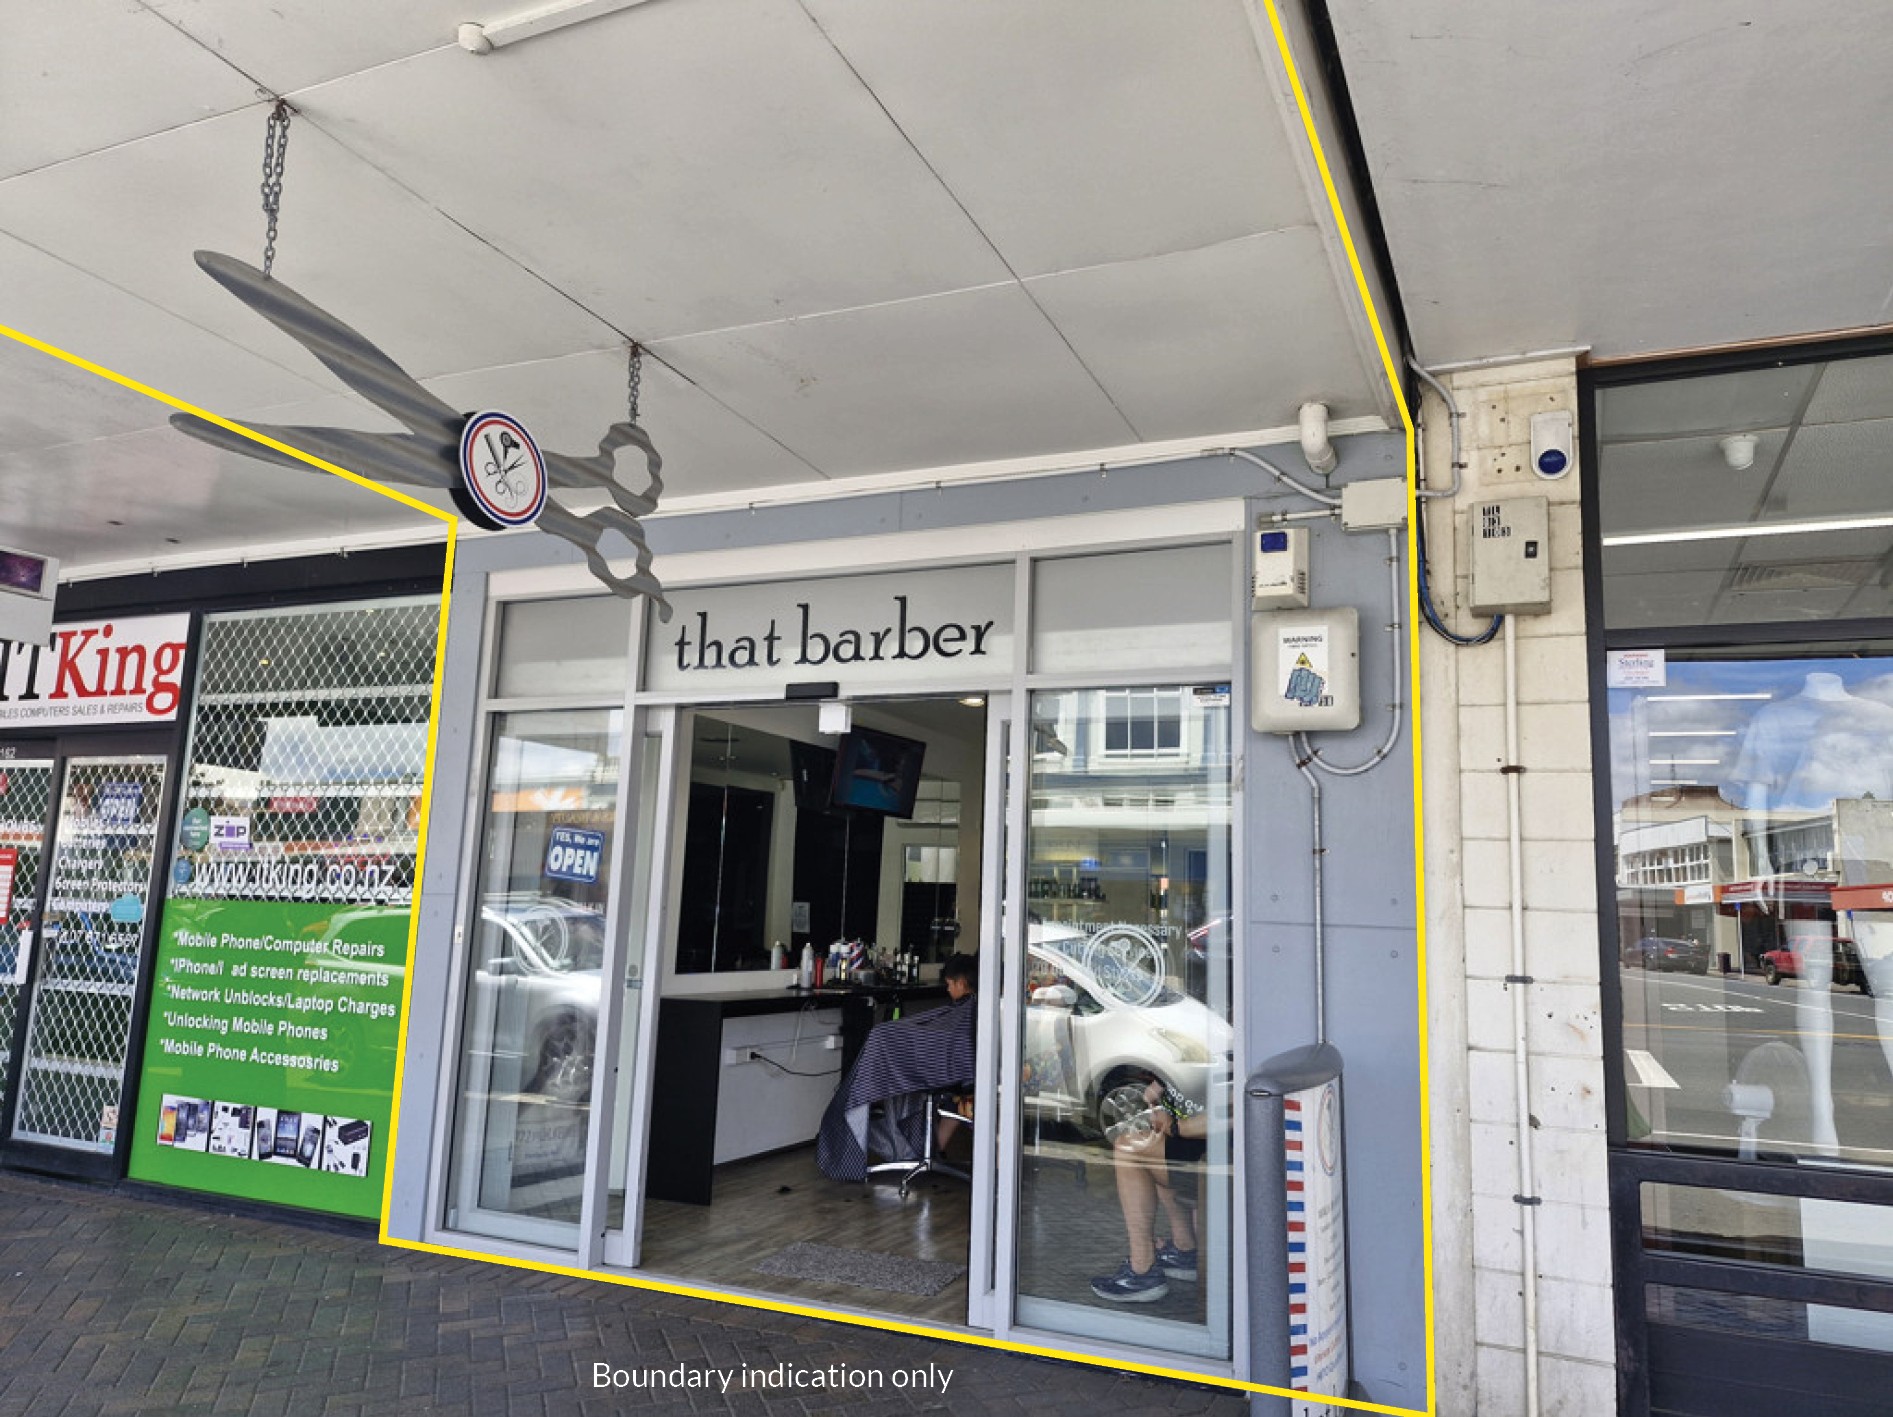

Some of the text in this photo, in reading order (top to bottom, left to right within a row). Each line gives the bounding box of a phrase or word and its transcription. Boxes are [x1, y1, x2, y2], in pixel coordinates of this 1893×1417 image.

[674, 595, 994, 671] that barber
[1283, 635, 1323, 644] WARNING
[71, 704, 98, 716] SALES
[106, 702, 144, 714] REPAIRS
[550, 846, 598, 876] OPEN
[221, 932, 329, 954] Phone/Computer
[332, 938, 385, 957] Repairs
[250, 968, 293, 980] screen
[297, 968, 389, 987] replacements
[224, 989, 334, 1013] Unblocks/Laptop
[337, 996, 396, 1019] Charges
[232, 1017, 274, 1035] Mobile
[277, 1021, 328, 1040] Phones
[206, 1042, 247, 1062] Phone
